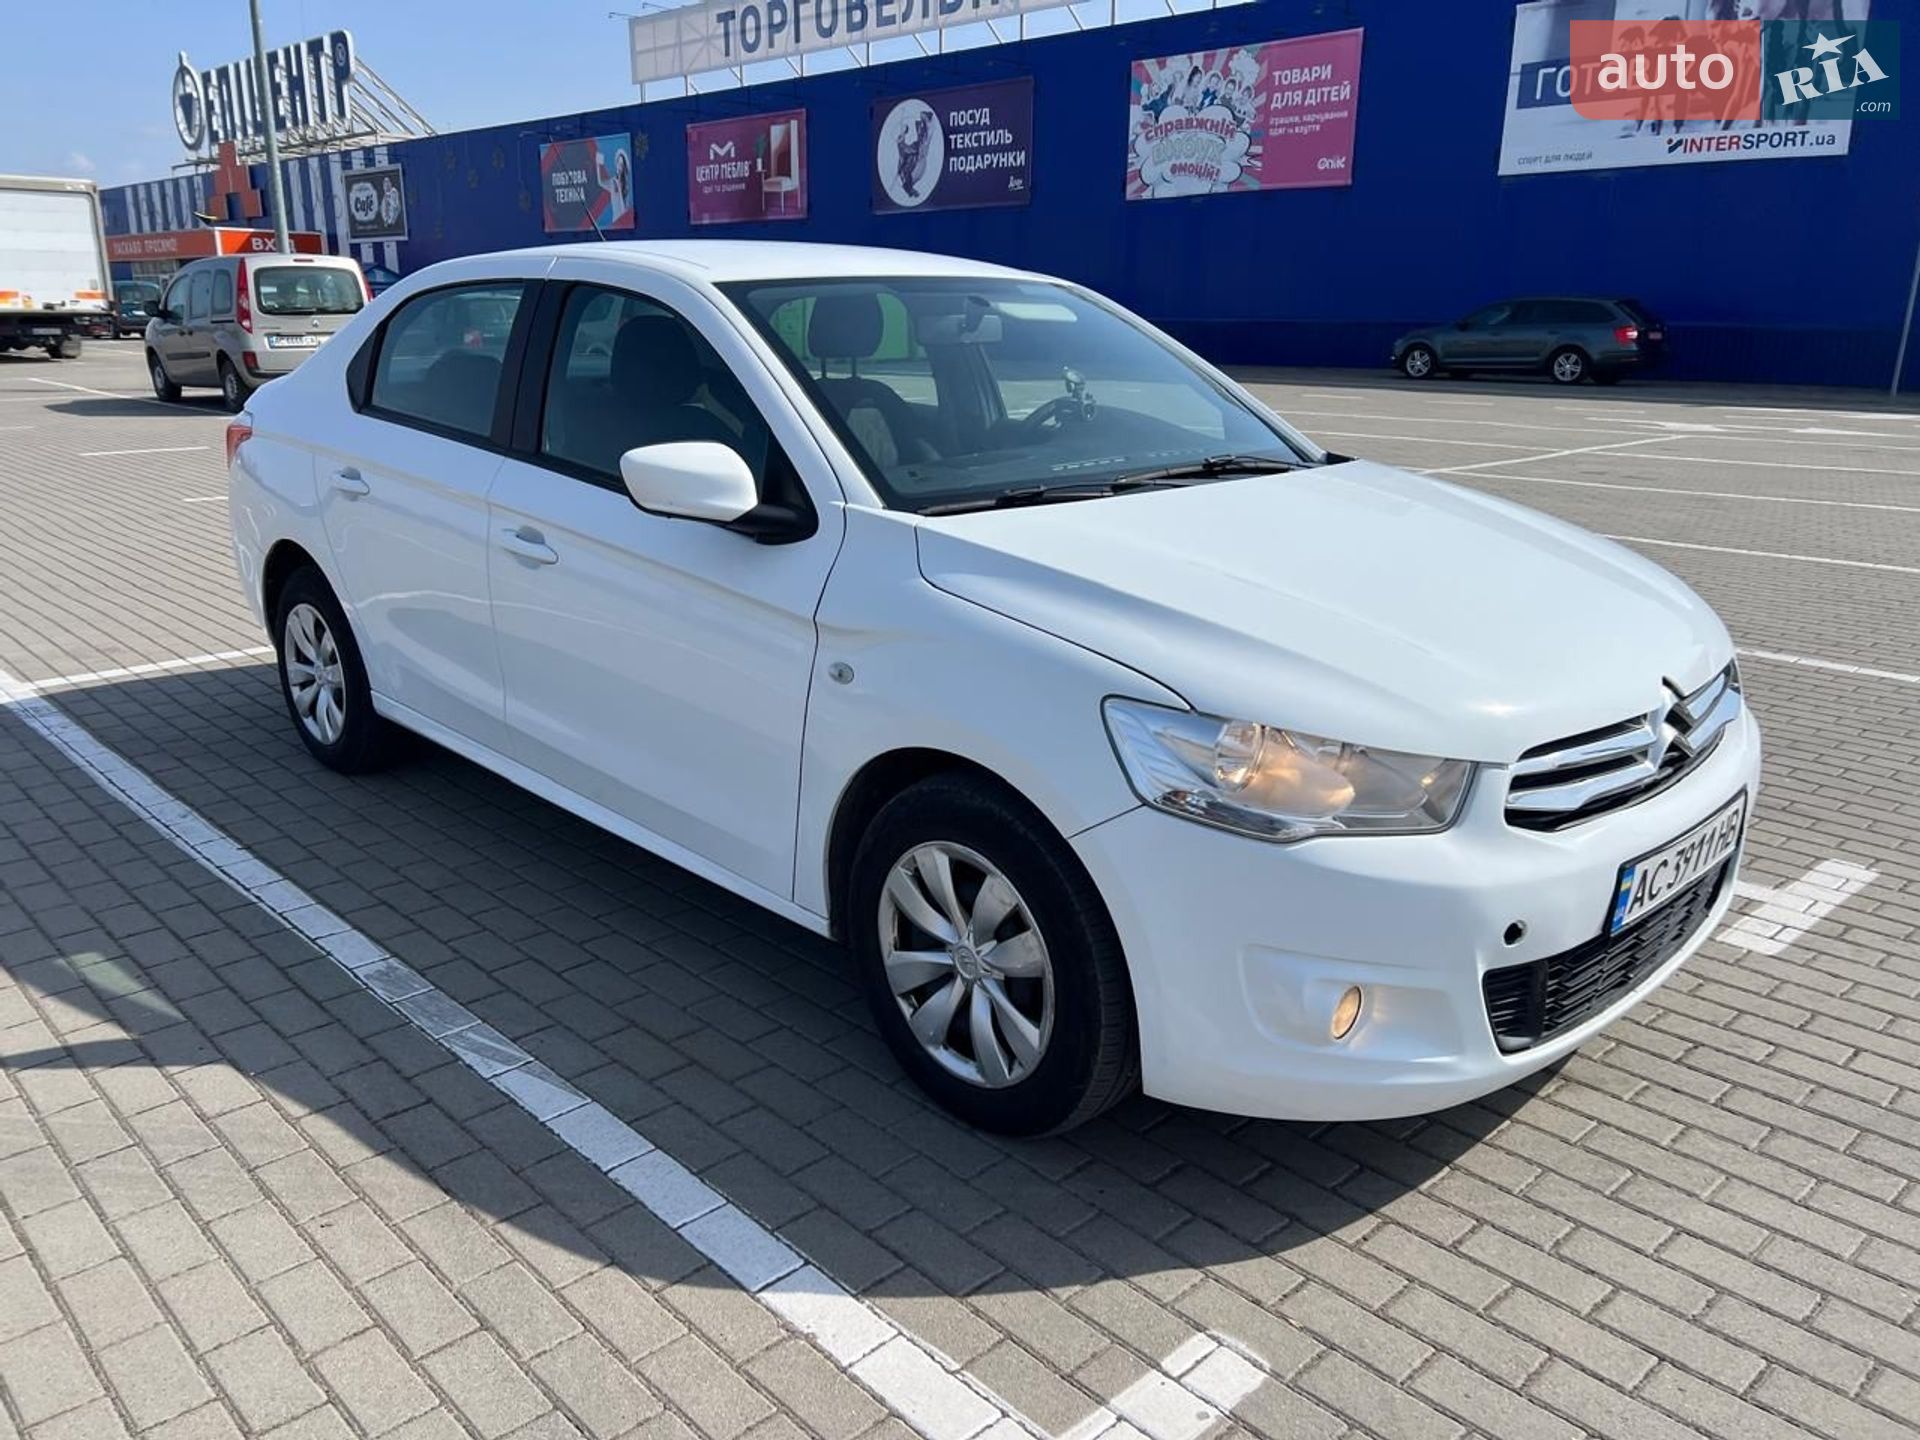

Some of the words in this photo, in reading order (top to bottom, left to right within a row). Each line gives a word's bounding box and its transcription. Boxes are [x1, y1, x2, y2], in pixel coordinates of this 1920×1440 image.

[715, 0, 1000, 57] ТОРГОВЕ
[1272, 64, 1332, 86] ТОВАРИ
[1270, 90, 1302, 110] ДЛЯ
[1304, 80, 1351, 107] ДІТЕЙ
[949, 107, 990, 127] ПОСУД
[948, 128, 1013, 150] ТЕКСТИЛЬ
[1682, 130, 1836, 154] INTERSPORT.ua
[949, 150, 1026, 173] ПОДАРУНКИ
[252, 237, 296, 253] ВХД
